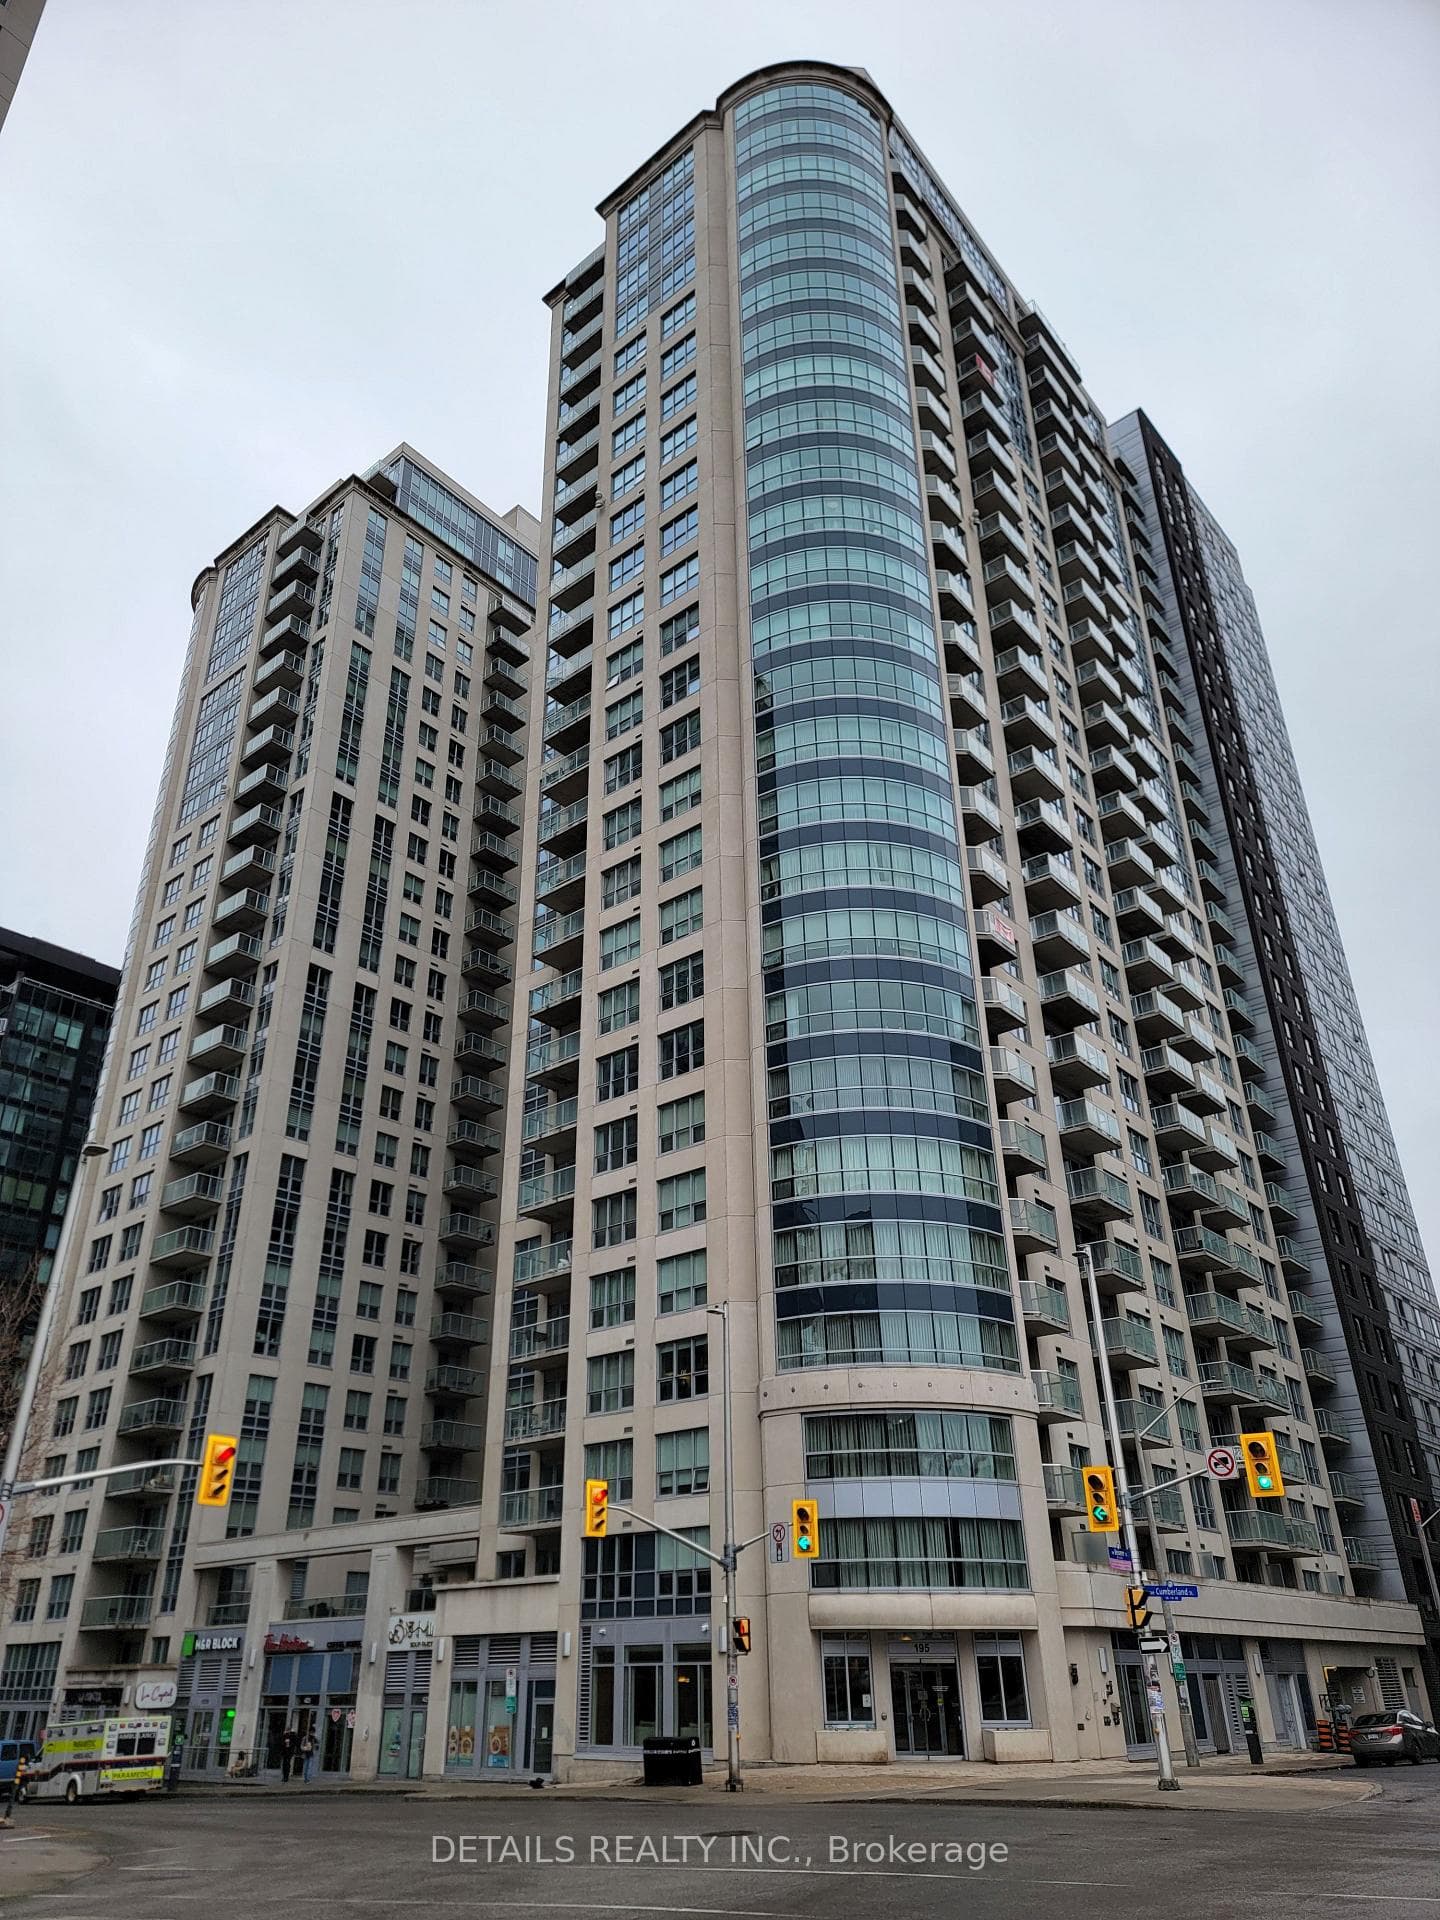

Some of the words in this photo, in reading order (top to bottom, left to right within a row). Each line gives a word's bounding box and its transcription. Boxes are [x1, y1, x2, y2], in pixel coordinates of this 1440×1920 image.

[1155, 1587, 1189, 1596] Cumberland
[195, 1638, 211, 1650] H&R
[212, 1637, 239, 1649] BLOCK
[915, 1643, 930, 1653] 195
